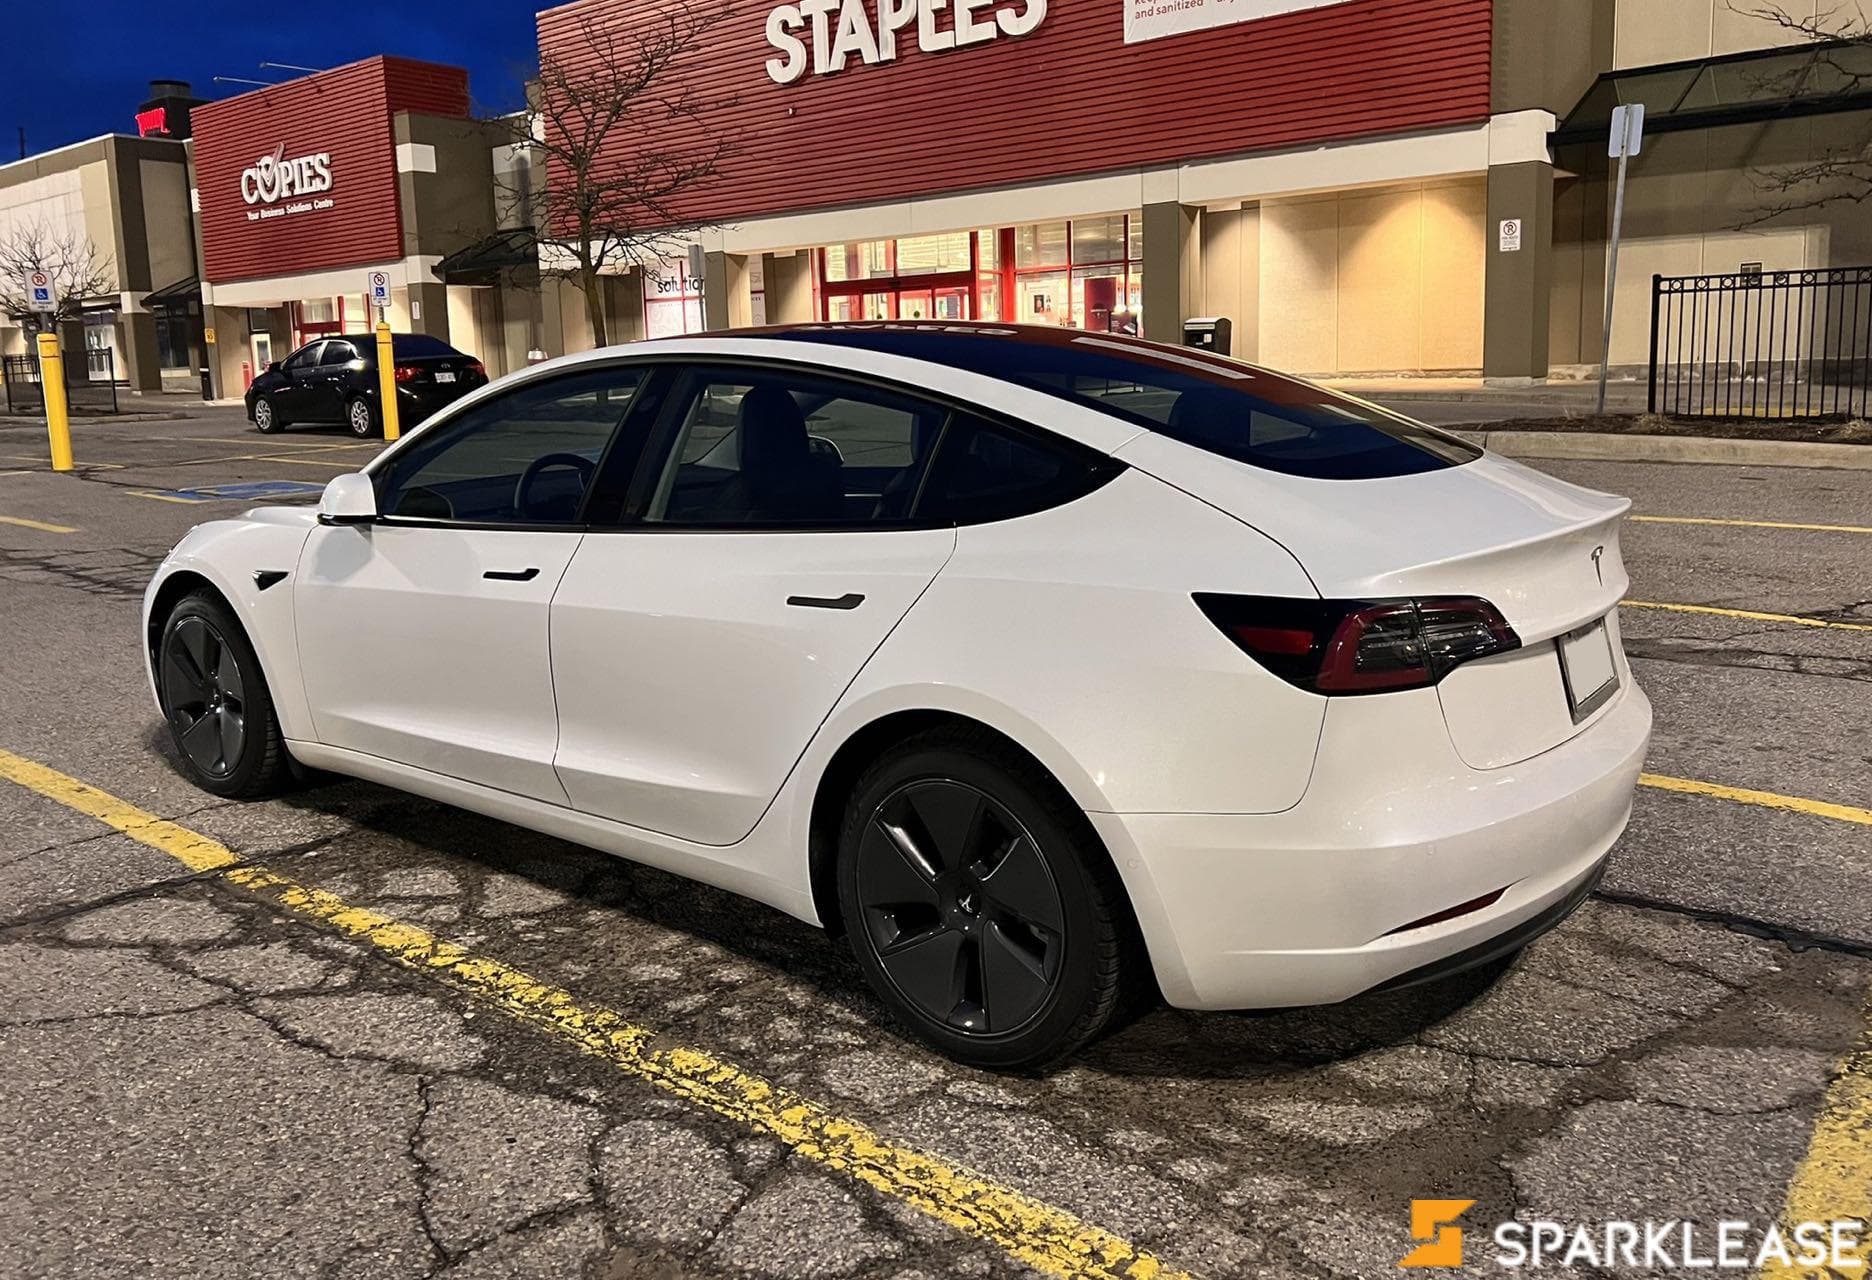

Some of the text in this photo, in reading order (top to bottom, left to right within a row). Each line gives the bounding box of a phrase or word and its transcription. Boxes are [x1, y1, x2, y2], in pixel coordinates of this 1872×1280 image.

[1135, 7, 1154, 19] and
[241, 152, 333, 204] COPIES
[285, 202, 313, 214] Solutions
